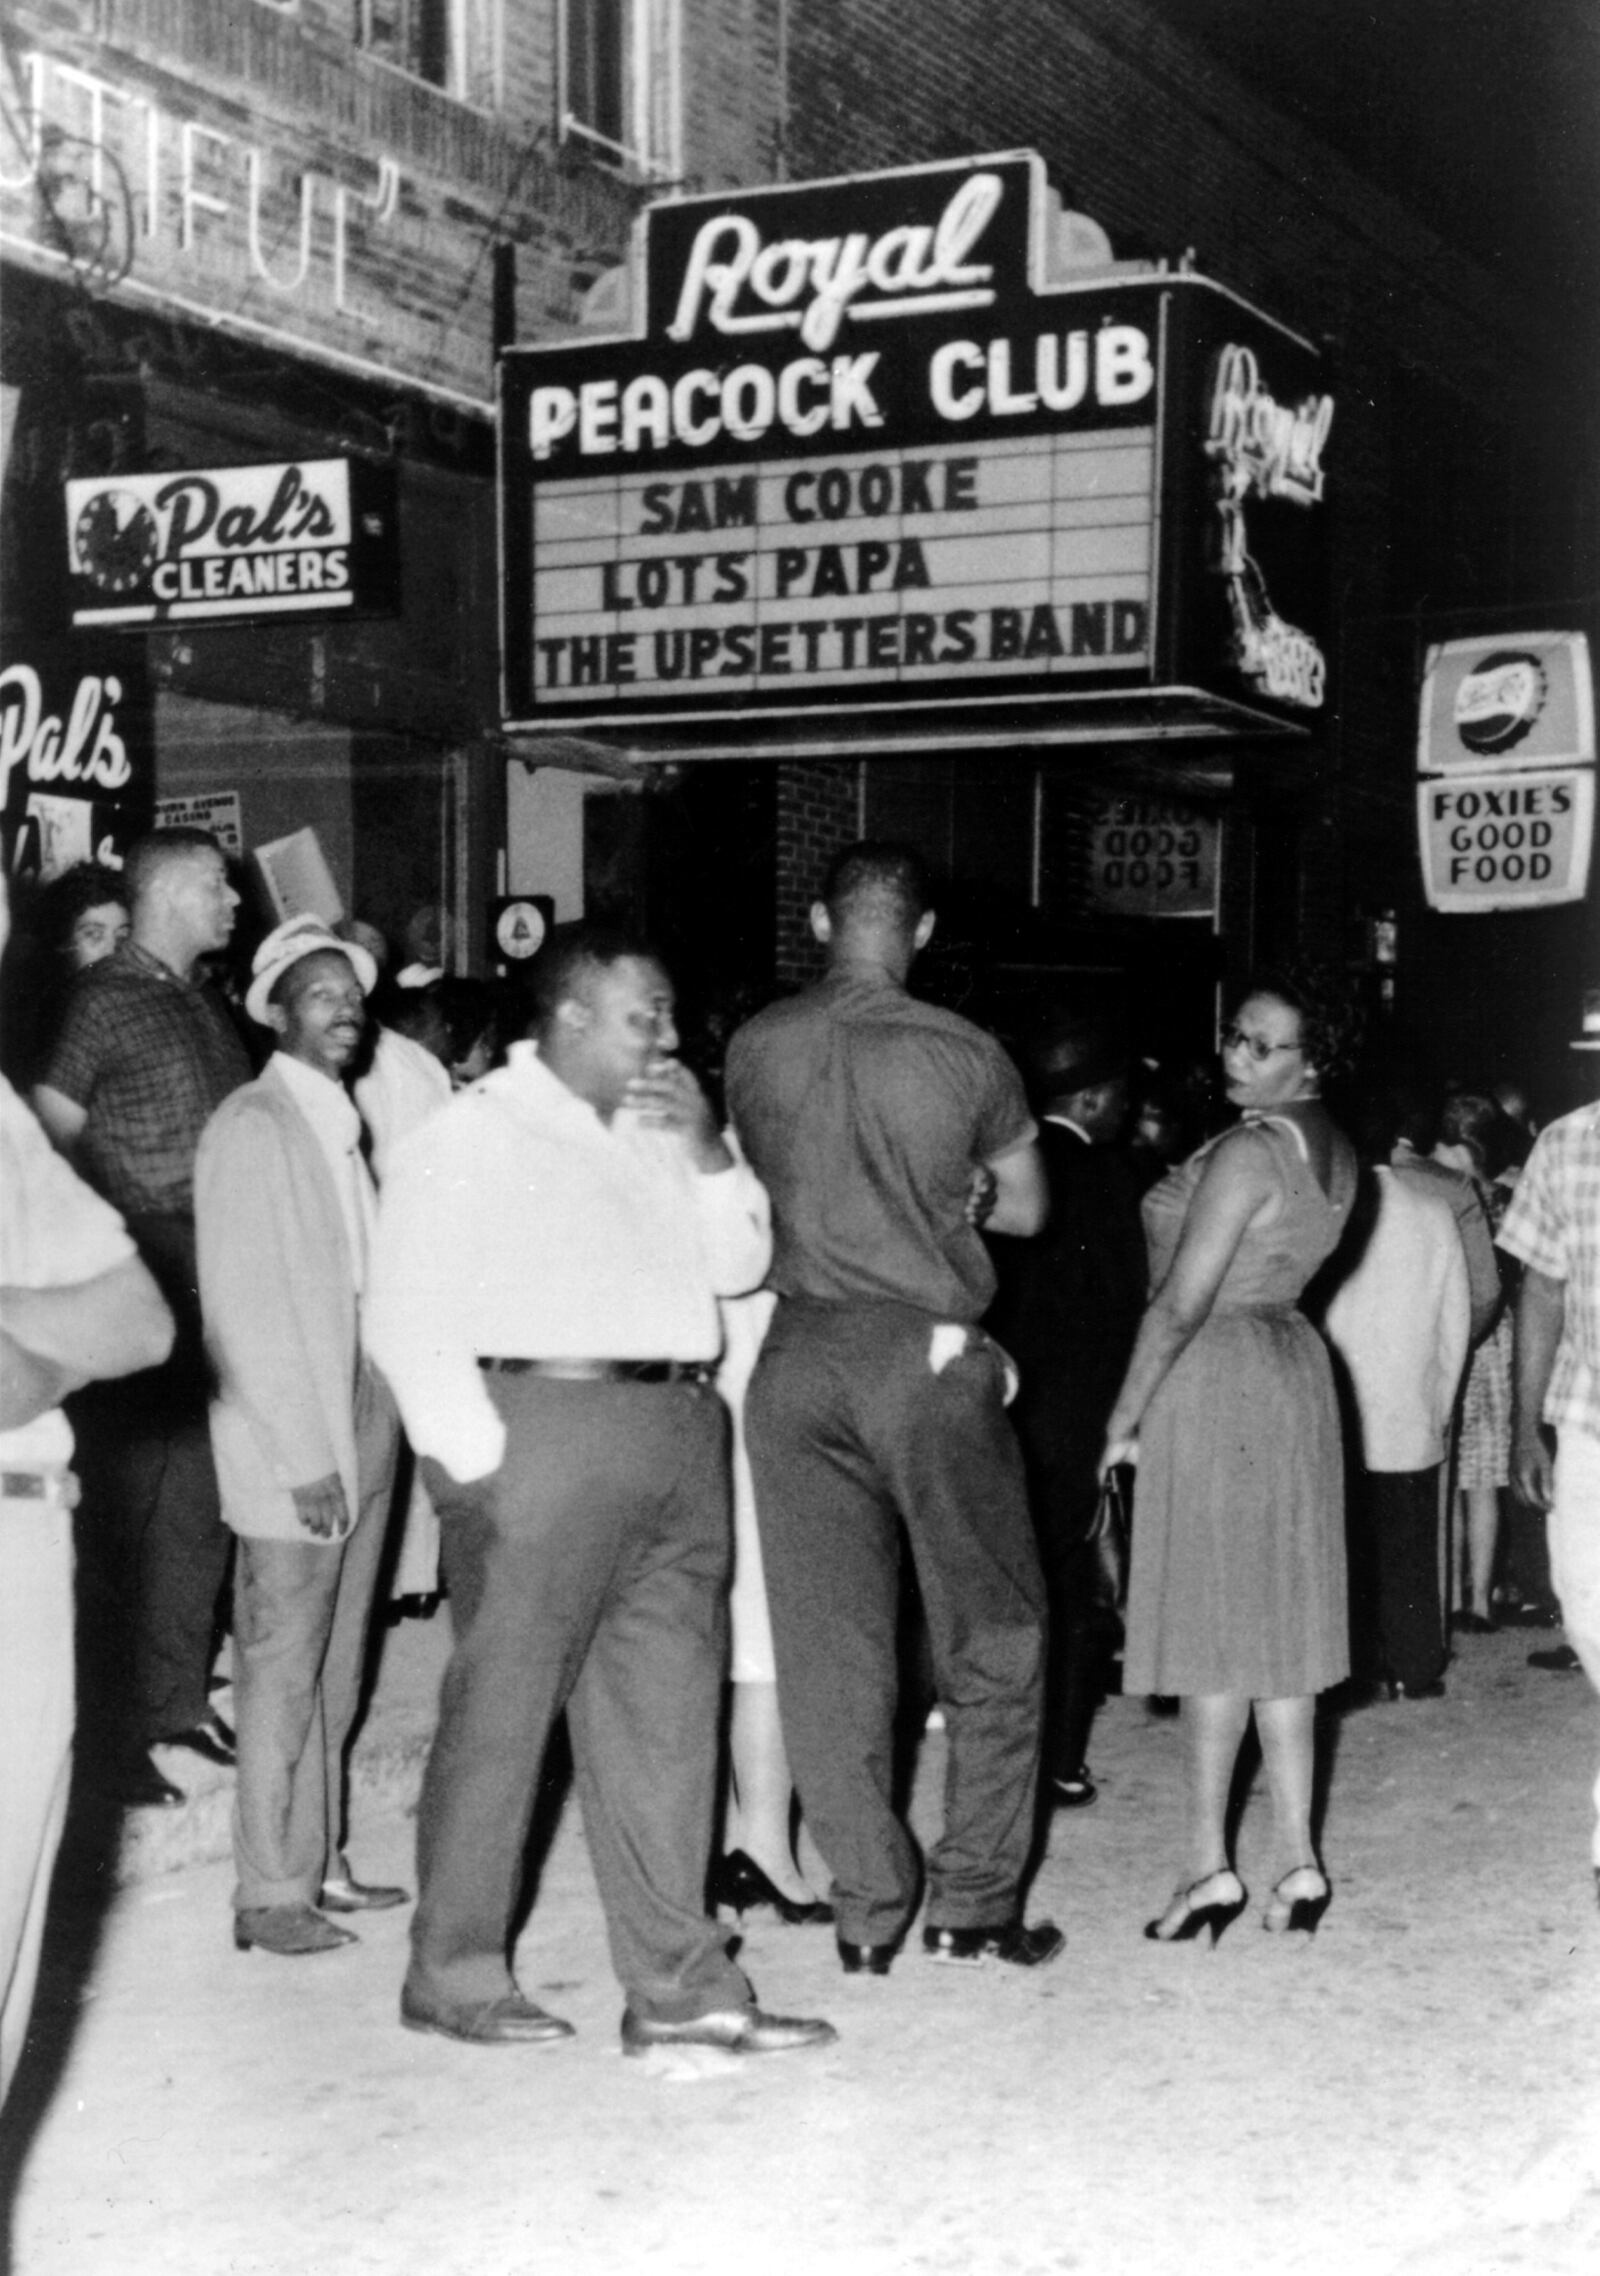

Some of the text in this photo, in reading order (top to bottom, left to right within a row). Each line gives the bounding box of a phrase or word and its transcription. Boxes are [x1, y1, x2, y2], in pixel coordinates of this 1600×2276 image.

[666, 173, 1003, 351] Royal
[528, 324, 1155, 460] PEACOCK CLUB
[152, 465, 337, 559] Pal's
[639, 456, 980, 536] SAM COOKE
[151, 550, 350, 600] CLEANERS
[601, 536, 933, 611] LOTS PAPA
[537, 600, 1151, 689] THE UPSETTERS BAND
[0, 663, 132, 810] Pal's
[1433, 784, 1571, 821] FOXIE'S
[1450, 820, 1553, 852] GOOD
[1450, 851, 1553, 885] FOOD
